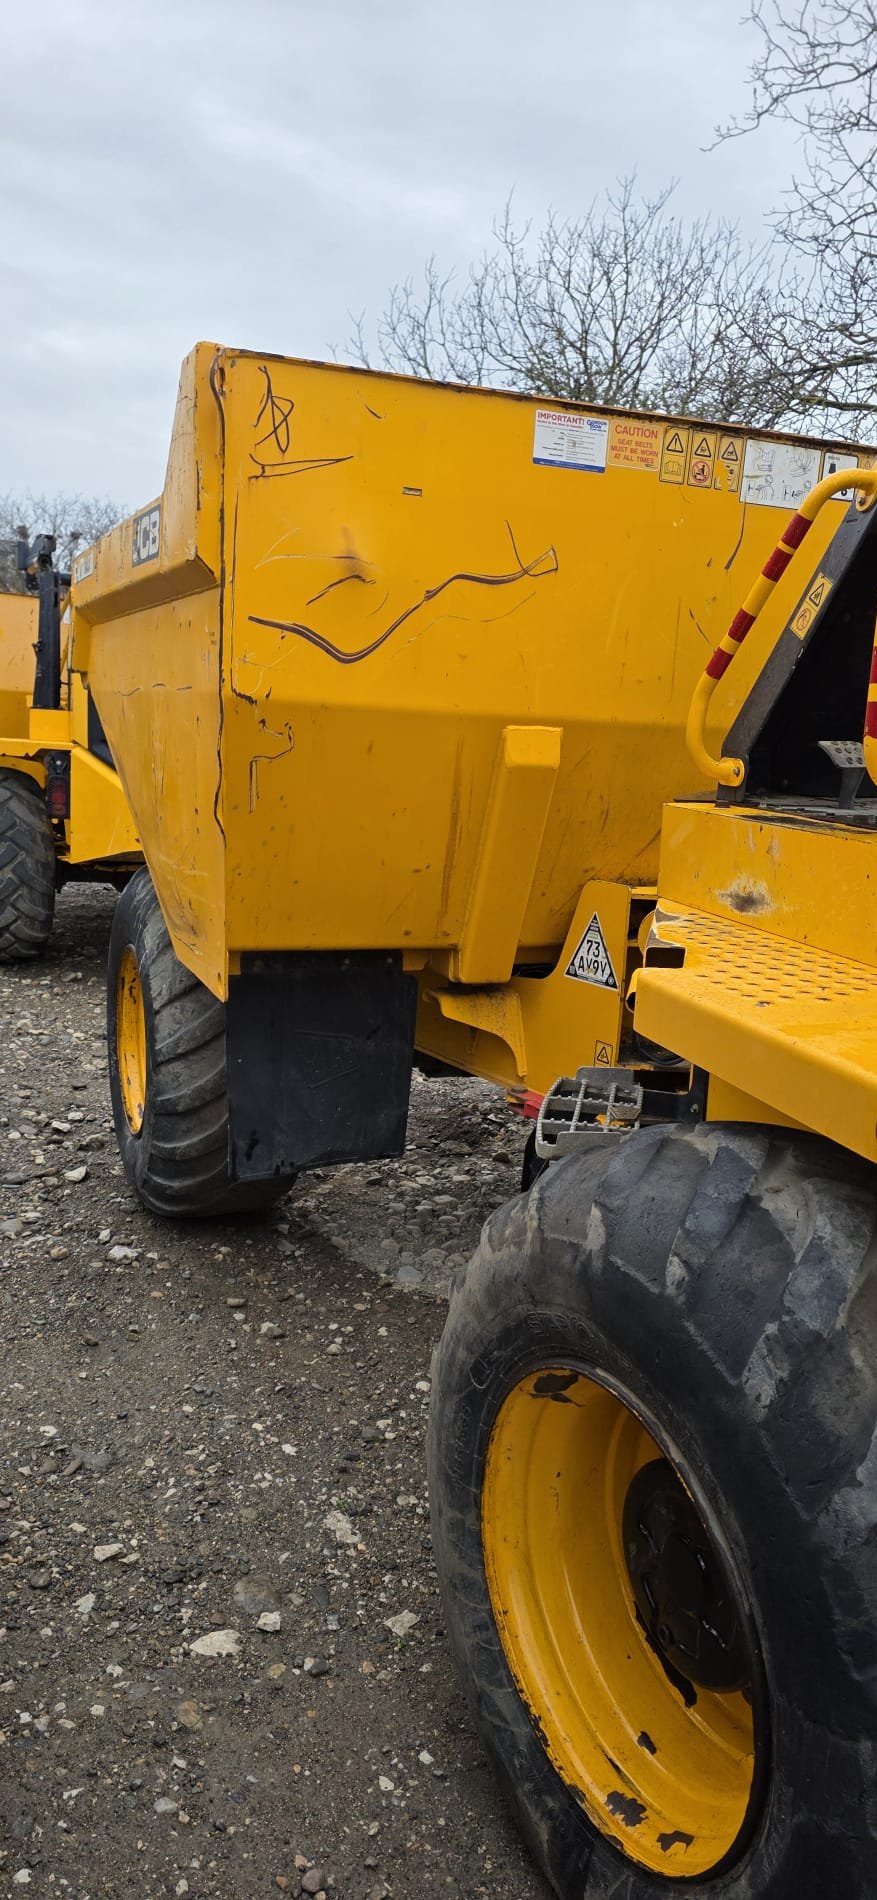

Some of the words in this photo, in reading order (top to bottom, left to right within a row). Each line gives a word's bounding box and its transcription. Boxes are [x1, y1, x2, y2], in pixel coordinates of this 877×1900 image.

[537, 411, 585, 426] IMPORTANT!
[614, 424, 658, 439] CAUTION
[610, 445, 628, 453] MUST
[630, 447, 638, 455] BE
[640, 449, 659, 457] WORN
[617, 438, 633, 446] SEAT
[635, 440, 653, 449] BELTS
[623, 454, 634, 462] ALL
[637, 456, 655, 464] TIMES
[132, 509, 160, 564] JCB
[586, 939, 600, 958] 73
[578, 955, 607, 978] AV9Y
